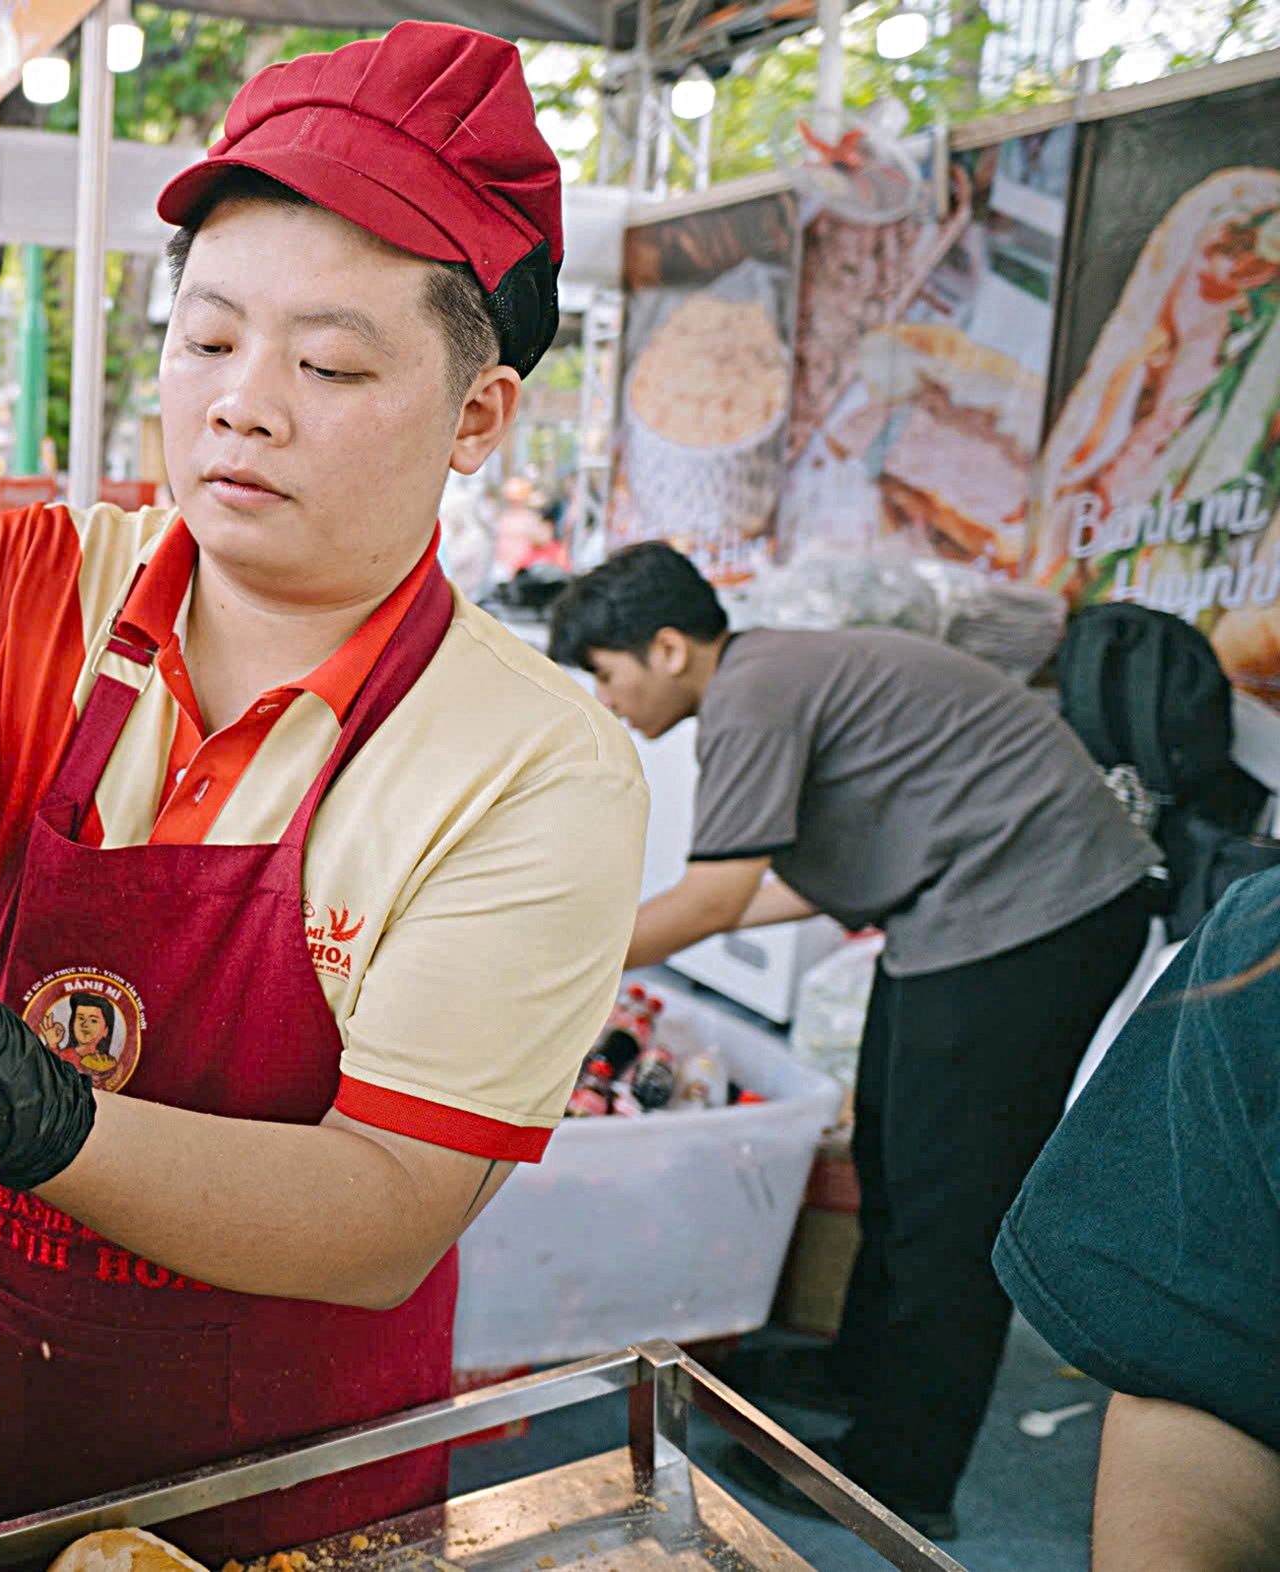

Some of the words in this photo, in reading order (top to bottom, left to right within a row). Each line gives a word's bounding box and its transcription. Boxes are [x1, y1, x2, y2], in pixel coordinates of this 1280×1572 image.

[310, 943, 351, 972] HOA
[64, 979, 104, 992] BÁNH
[105, 985, 122, 1001] MÌ
